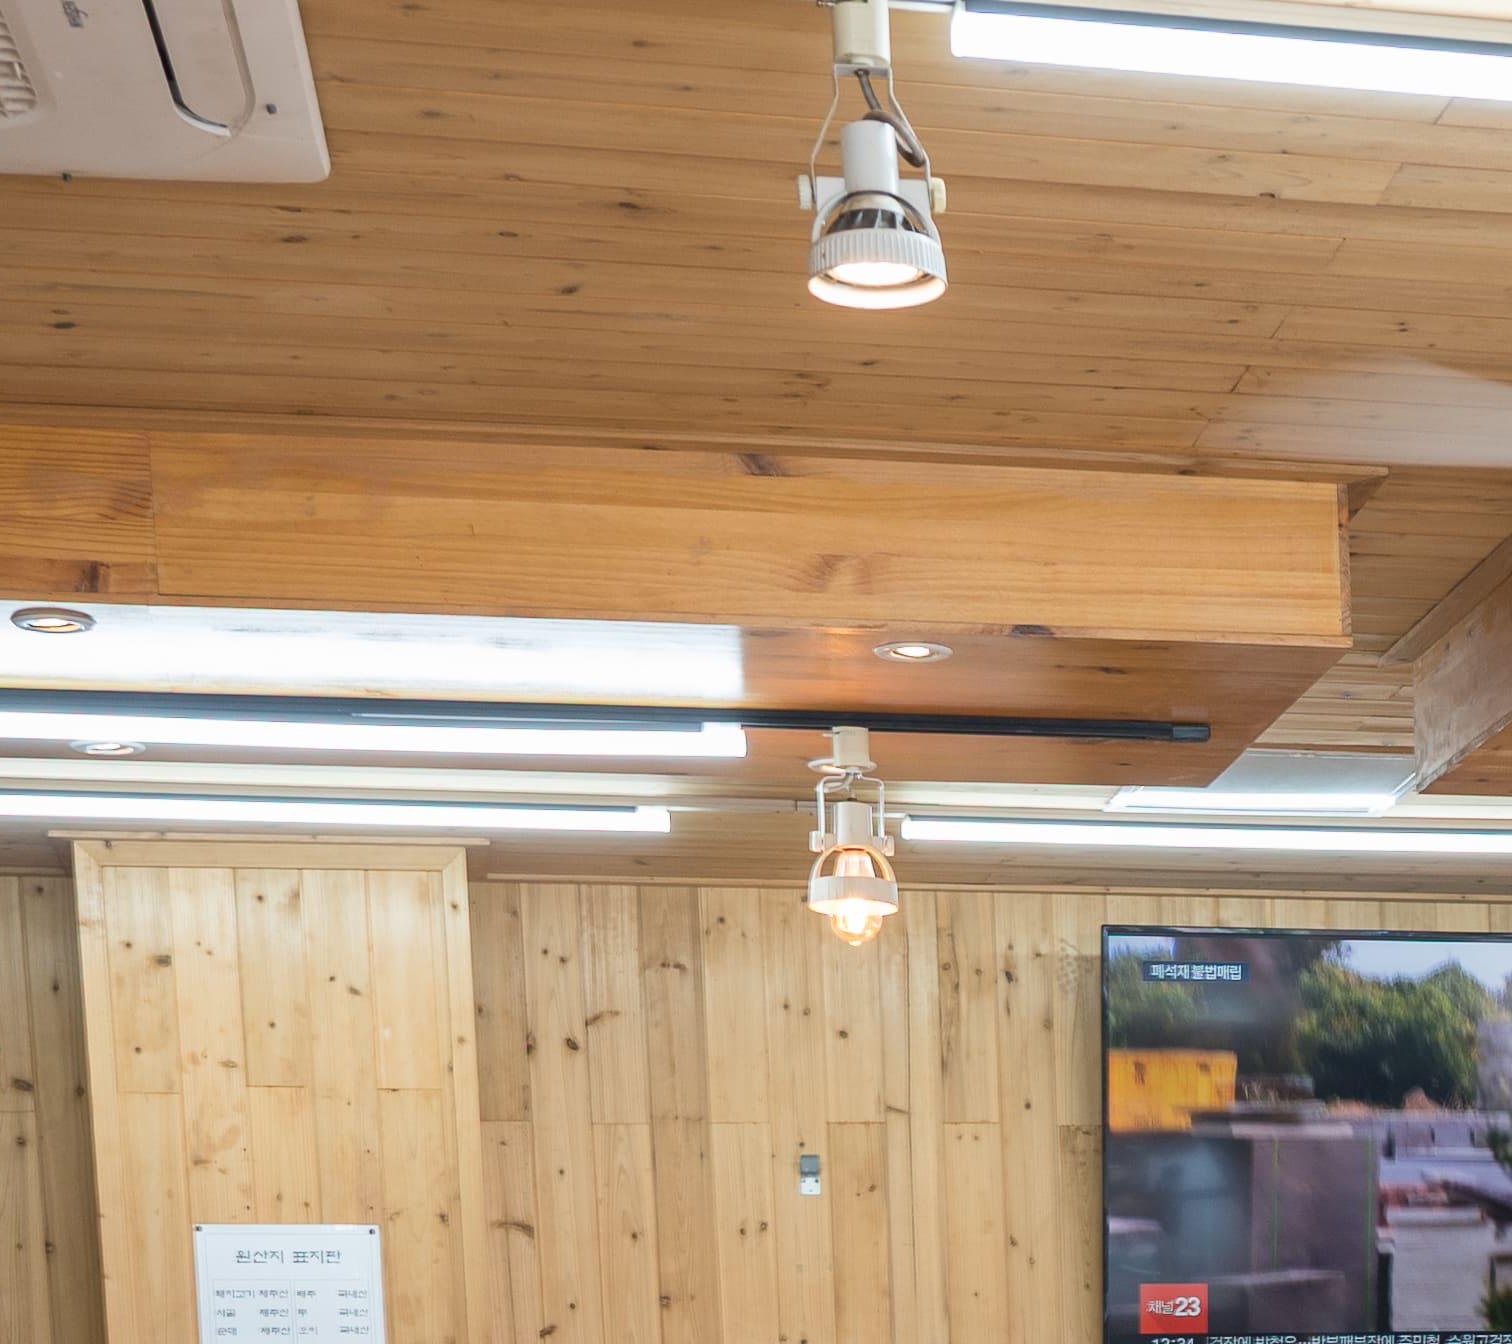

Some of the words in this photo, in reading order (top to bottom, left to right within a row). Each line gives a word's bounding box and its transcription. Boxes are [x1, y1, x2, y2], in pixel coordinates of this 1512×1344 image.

[1151, 964, 1189, 979] 폐석재
[1191, 964, 1242, 980] 불법매립
[236, 1250, 284, 1264] 원산지
